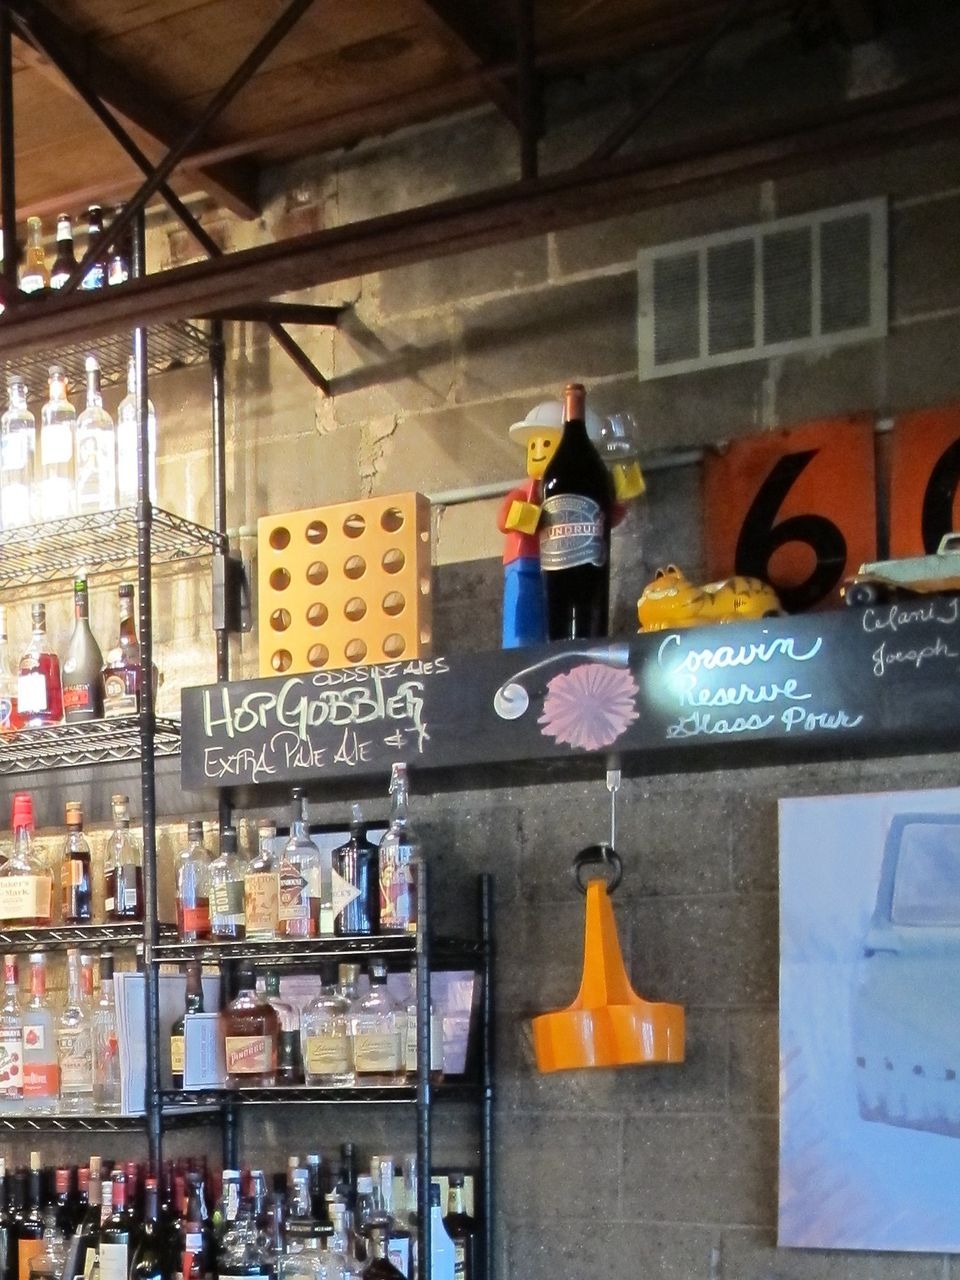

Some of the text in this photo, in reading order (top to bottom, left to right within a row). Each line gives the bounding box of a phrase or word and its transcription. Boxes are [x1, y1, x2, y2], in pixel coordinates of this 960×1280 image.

[658, 631, 822, 675] Coravin
[680, 677, 812, 706] Reserve
[781, 706, 863, 732] Pour
[5, 889, 30, 897] Mark
